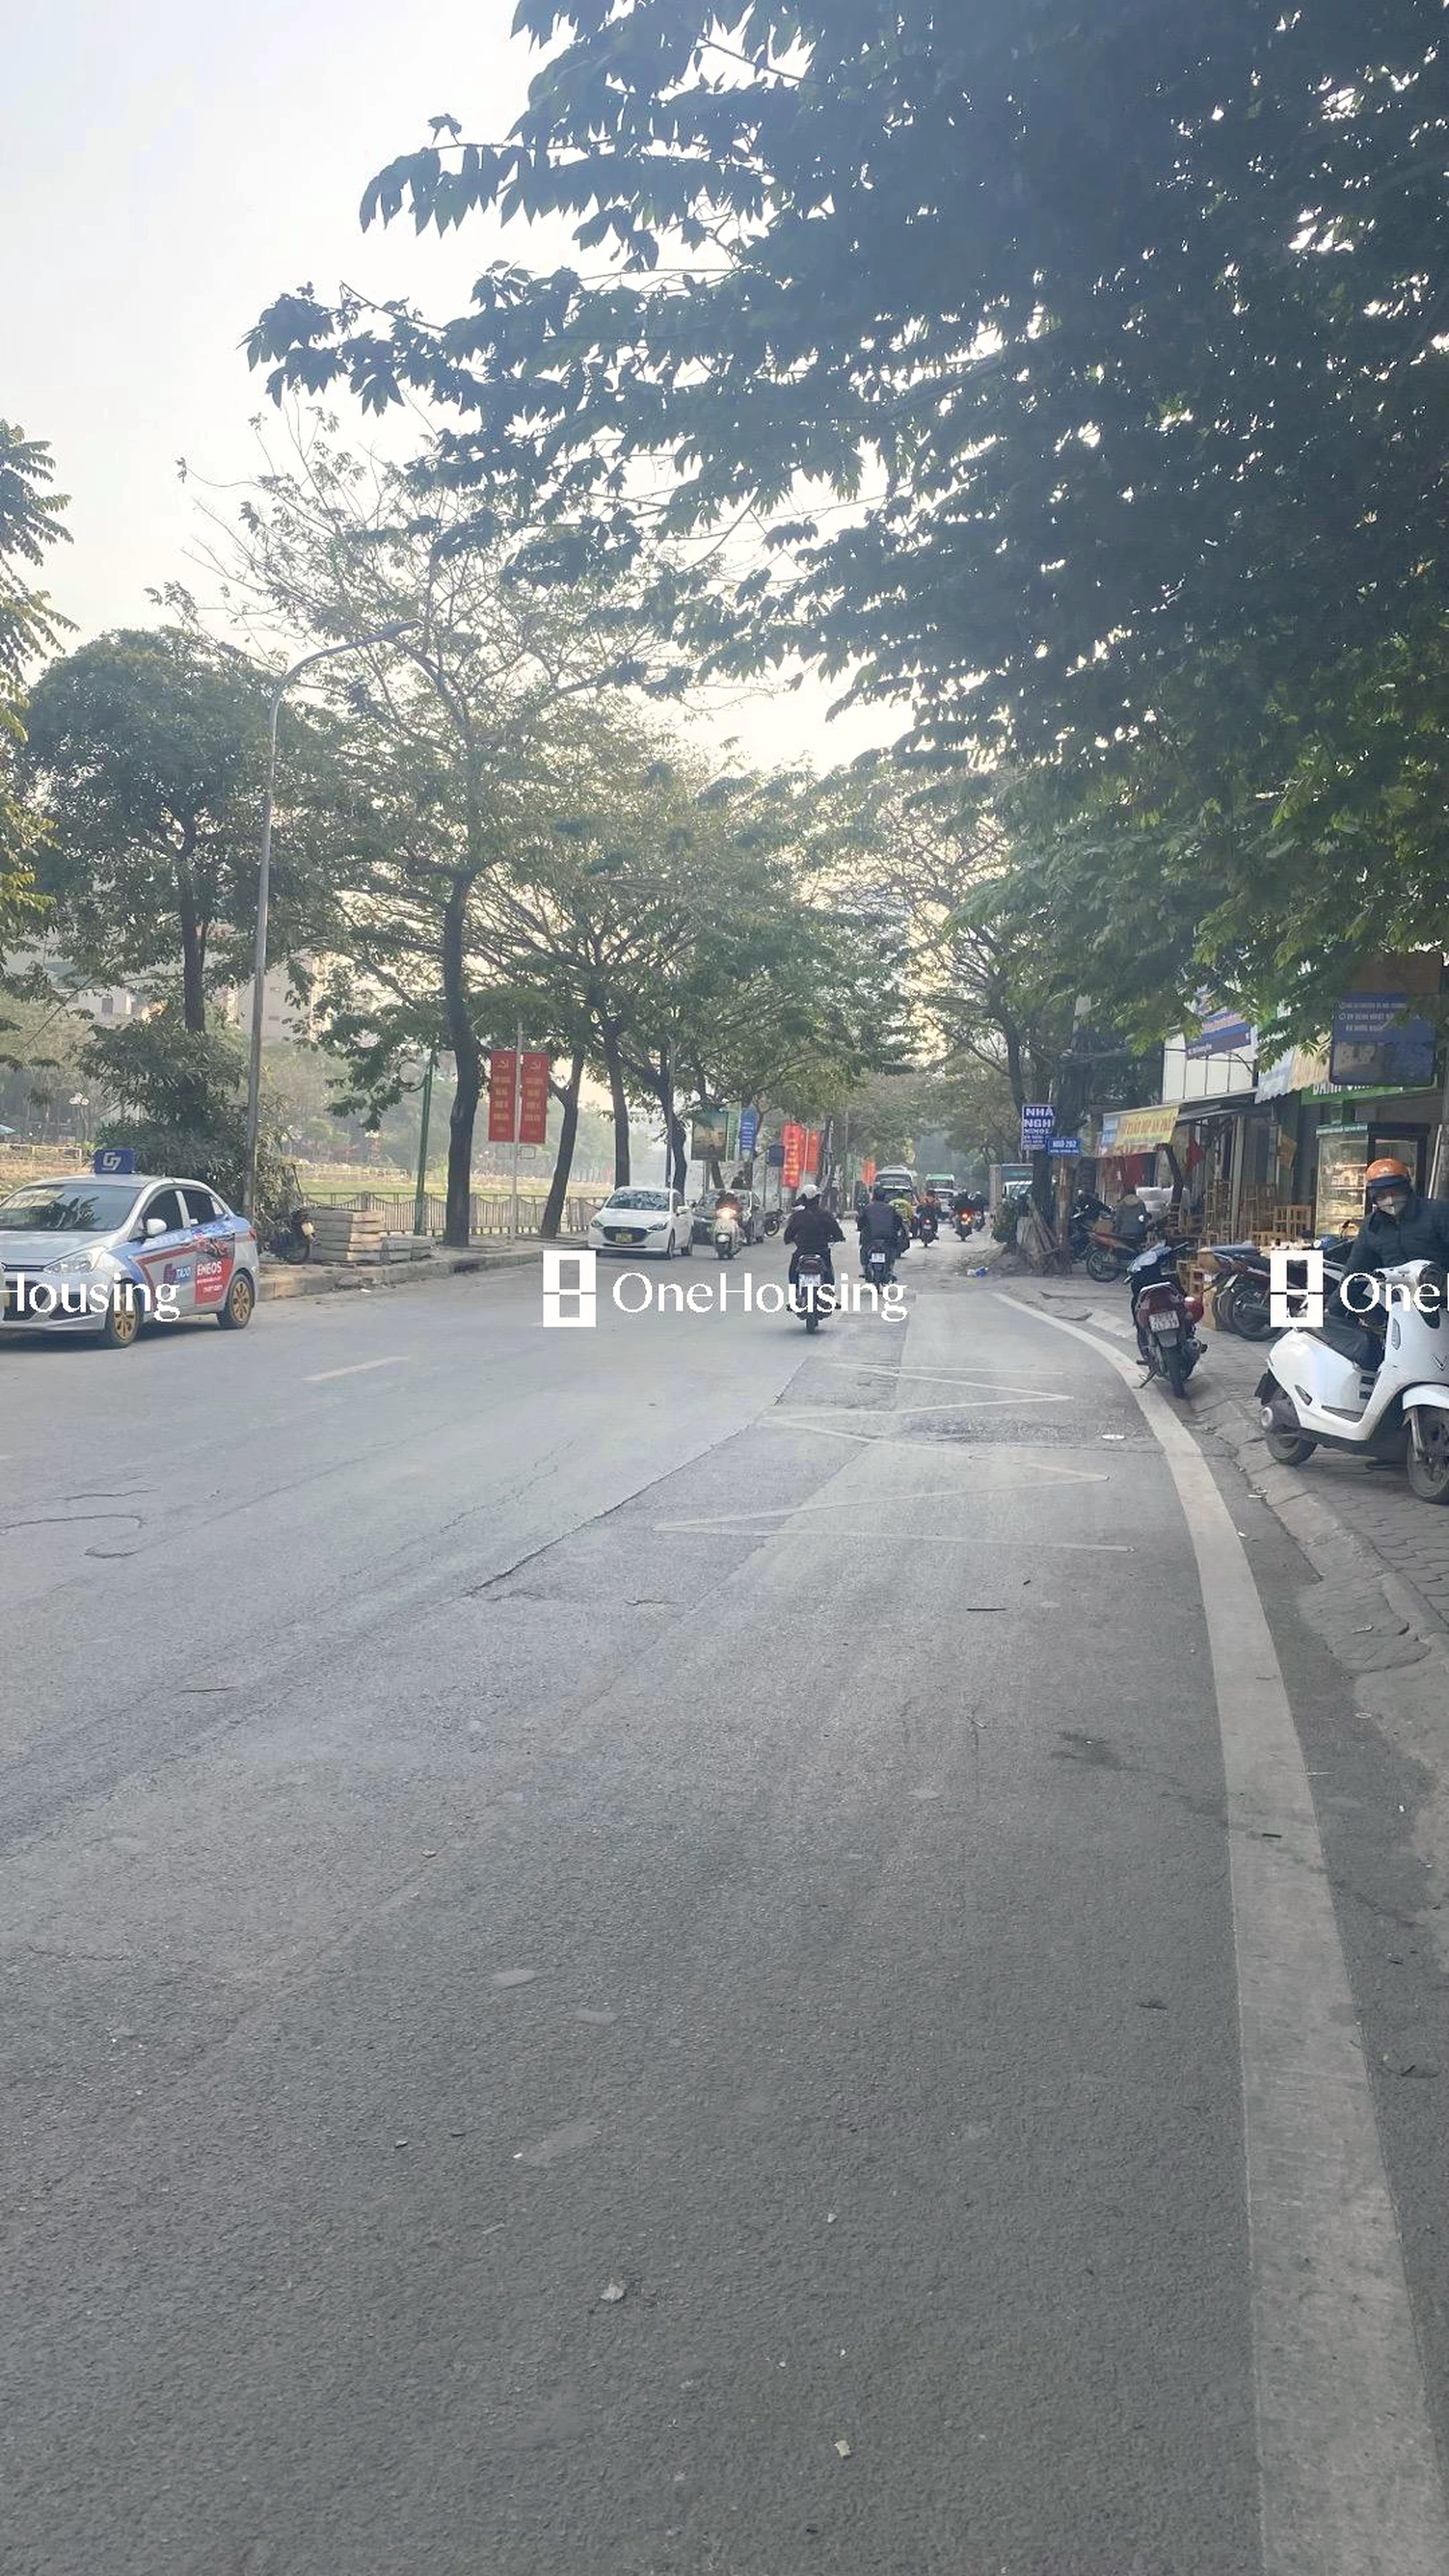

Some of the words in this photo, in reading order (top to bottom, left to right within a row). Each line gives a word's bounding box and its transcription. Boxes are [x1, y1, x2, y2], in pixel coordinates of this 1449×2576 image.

[1024, 1119, 1055, 1128] NGH
[103, 1152, 121, 1171] G7
[197, 1261, 223, 1276] ENEOS
